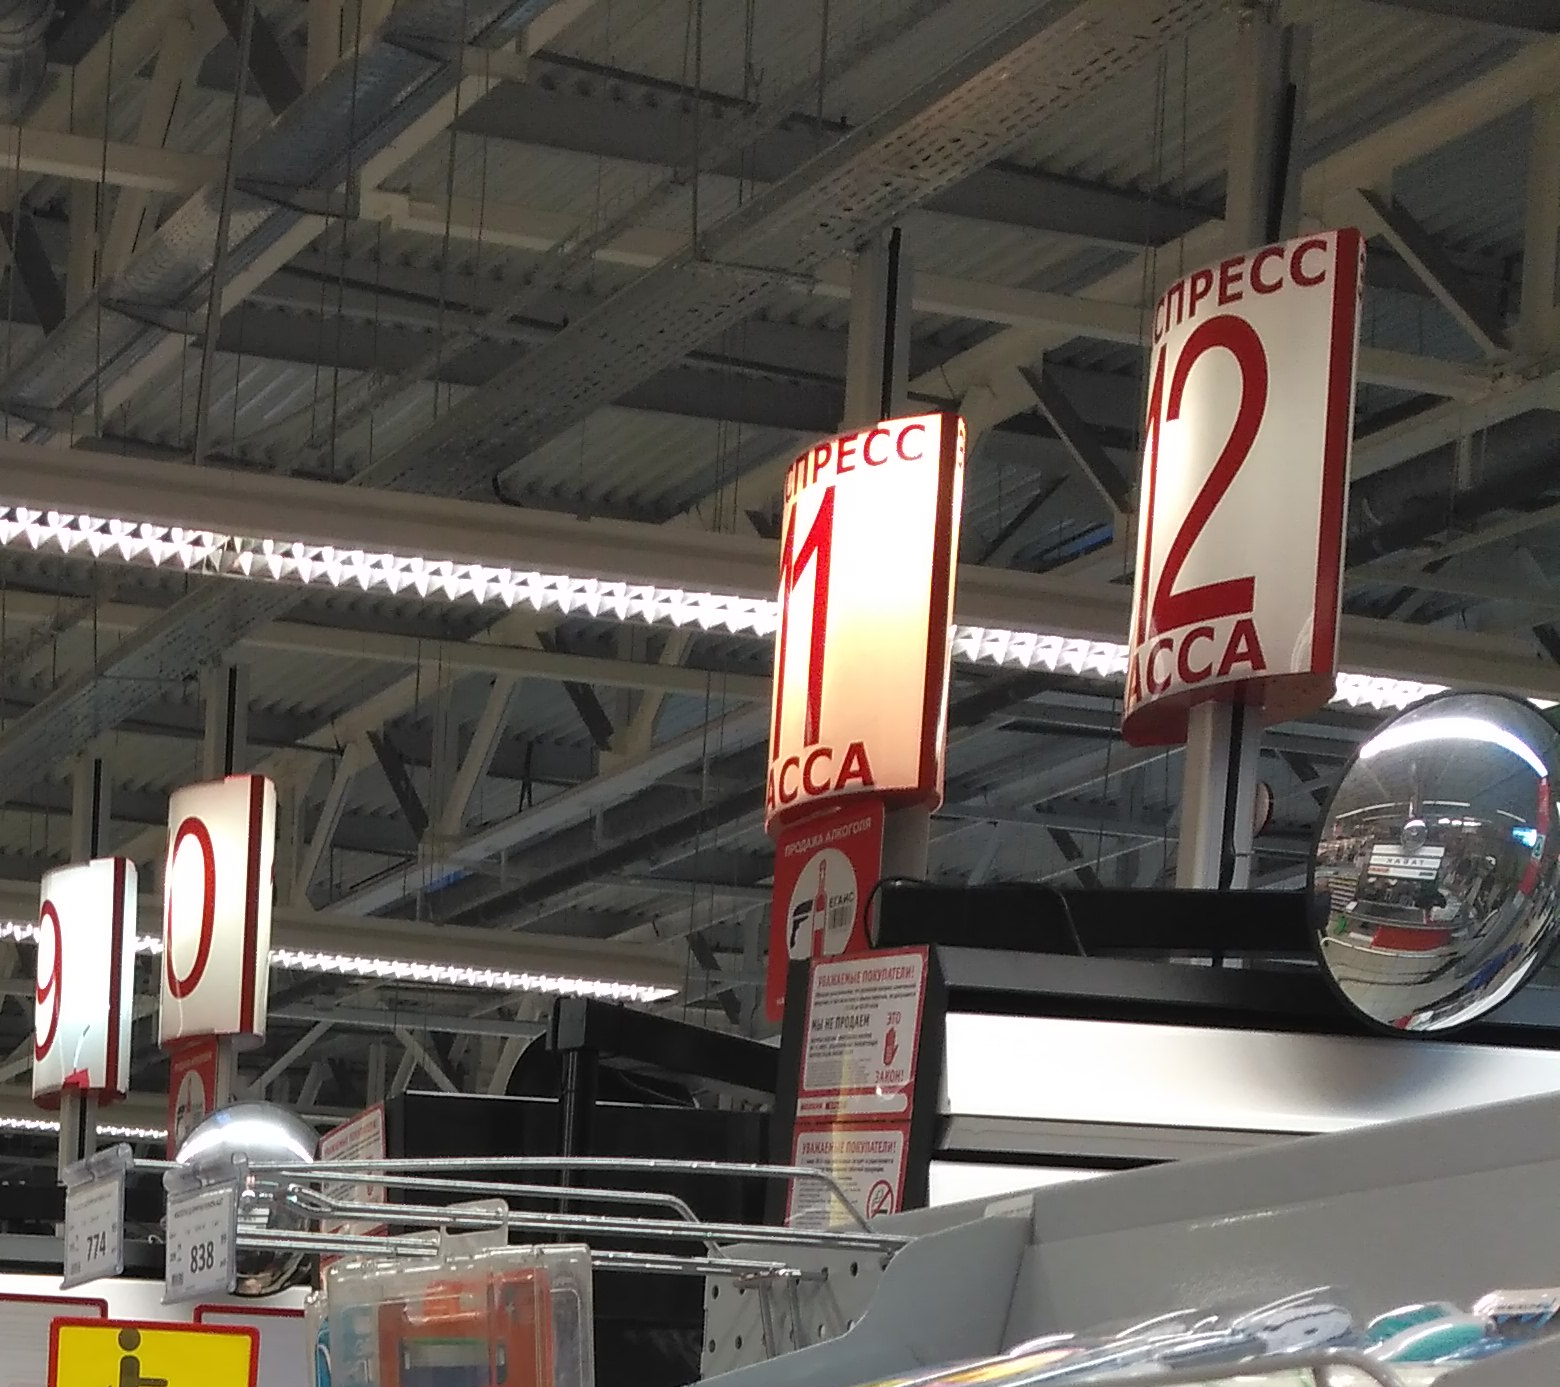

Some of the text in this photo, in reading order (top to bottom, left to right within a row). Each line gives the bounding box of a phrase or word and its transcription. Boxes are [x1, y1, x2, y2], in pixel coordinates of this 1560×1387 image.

[784, 816, 873, 858] ПРОДАЖА АЛКОГОЛЯ
[829, 891, 855, 909] ЕГАИС
[818, 966, 915, 988] УВАЖАЕМЫЕ ПОКУПАТЕЛИ!
[811, 1019, 823, 1031] МЫ
[825, 1015, 834, 1030] НЕ
[887, 1011, 902, 1026] ЭТО
[875, 1069, 904, 1084] ЗАКОН!
[86, 1231, 107, 1261] 774
[190, 1241, 215, 1274] 838
